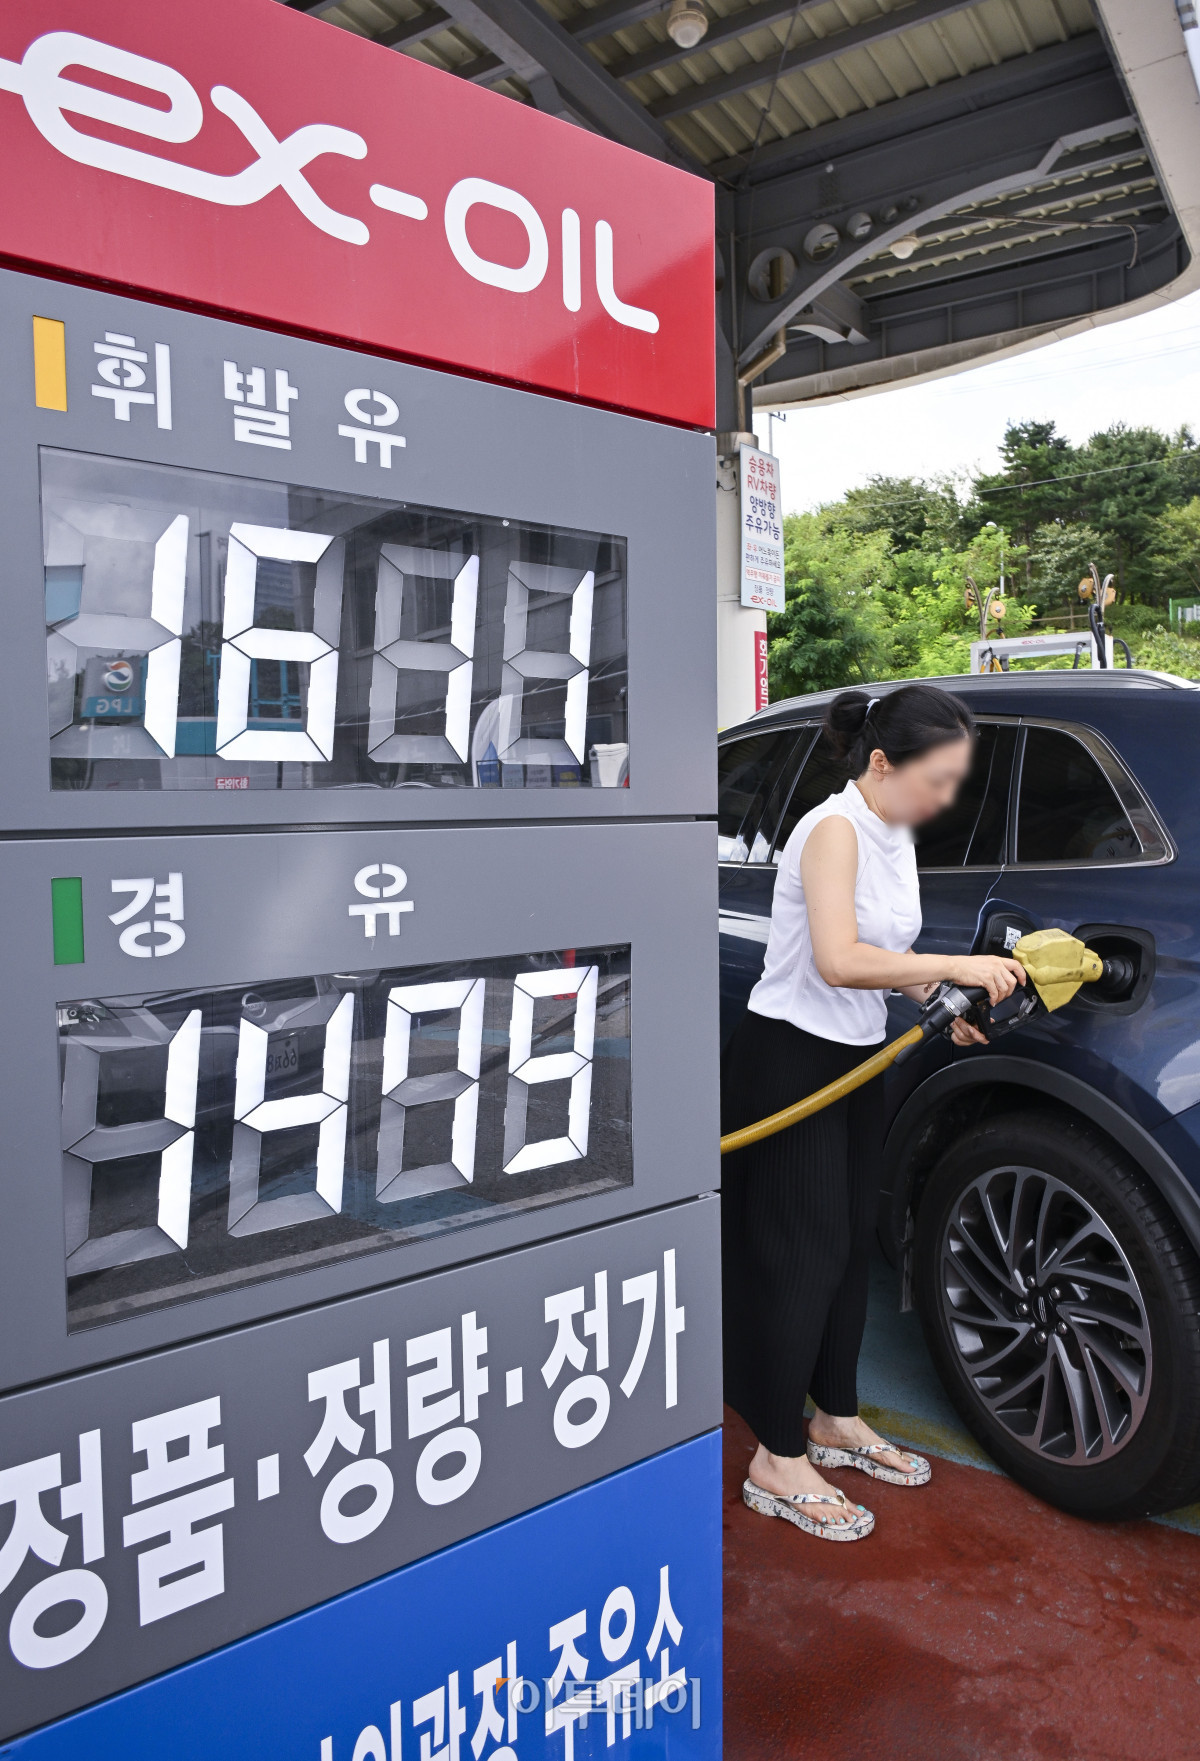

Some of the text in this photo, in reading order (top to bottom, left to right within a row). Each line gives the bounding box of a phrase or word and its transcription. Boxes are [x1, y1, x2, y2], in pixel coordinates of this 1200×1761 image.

[91, 330, 407, 470] 휘발유
[747, 474, 777, 500] RV차량
[749, 455, 774, 478] 승용차
[749, 495, 776, 519] 양방향
[745, 514, 781, 540] 주유가능
[143, 514, 595, 767] 1611
[156, 965, 599, 1251] 1479
[545, 1565, 688, 1761] 주유소
